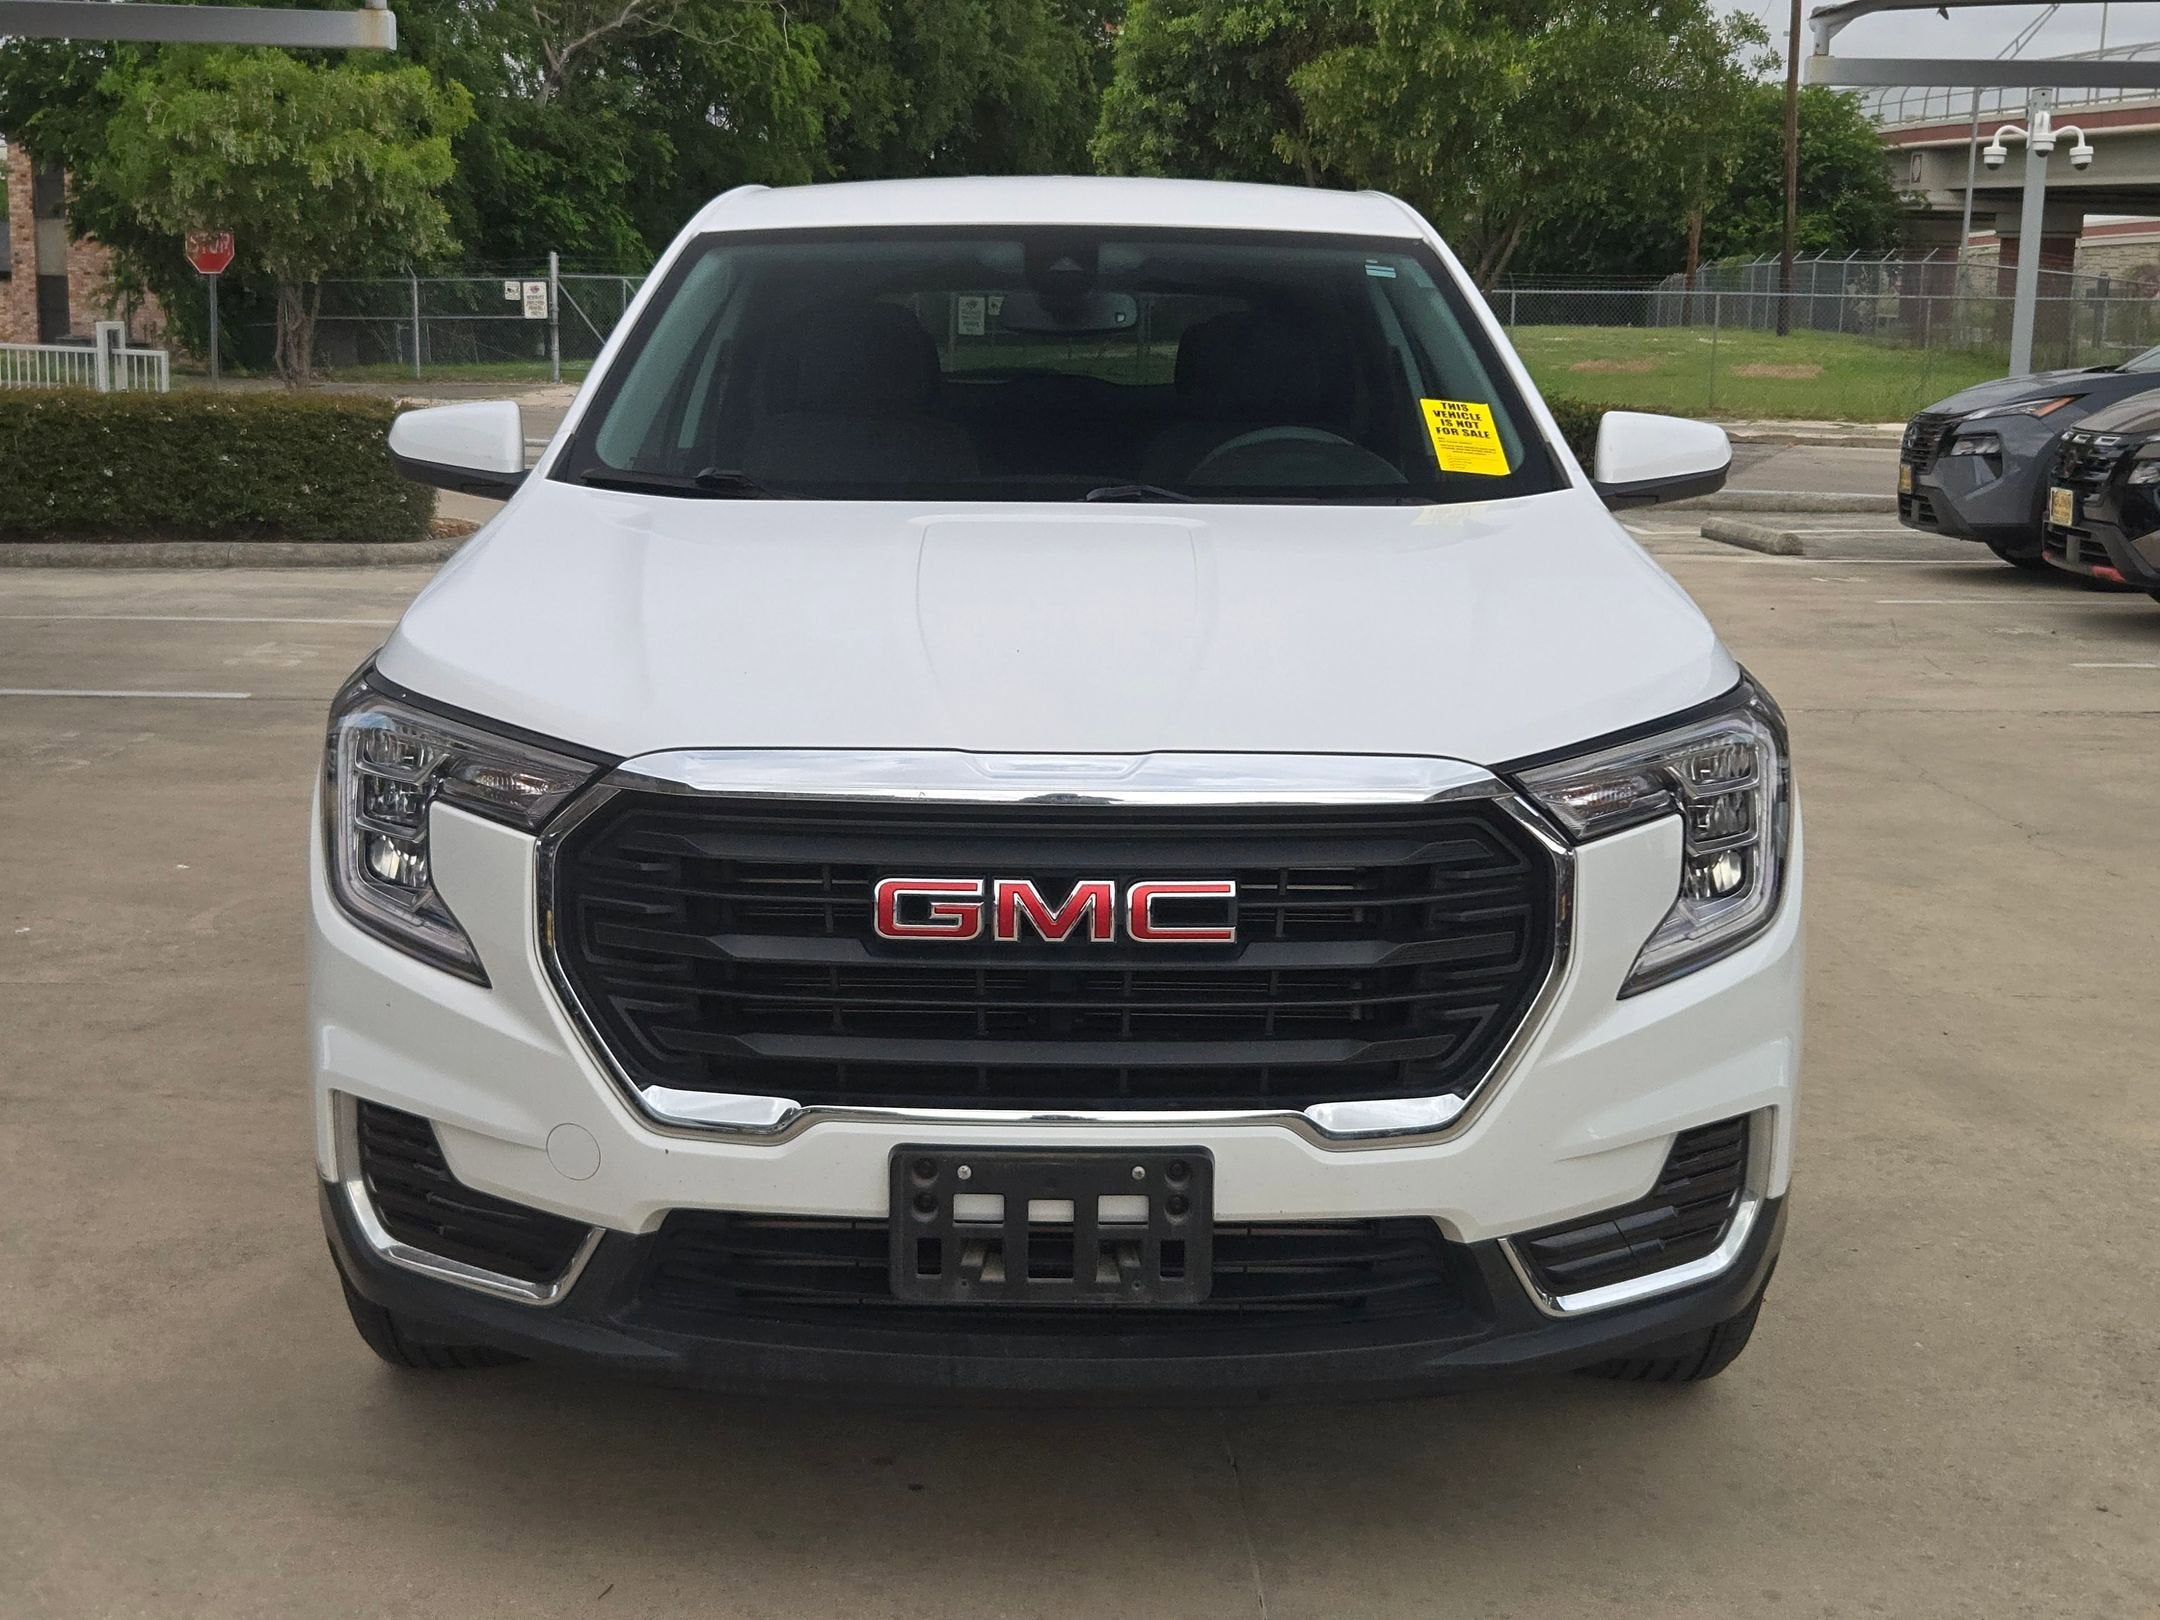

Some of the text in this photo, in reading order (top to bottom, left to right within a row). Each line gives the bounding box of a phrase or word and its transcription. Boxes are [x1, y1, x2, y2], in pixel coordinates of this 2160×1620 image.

[1441, 402, 1469, 412] THIS
[1433, 410, 1482, 421] VEHICLE
[1440, 419, 1479, 429] IS NOT
[1436, 427, 1491, 439] FOR SALE
[873, 877, 1237, 943] GMC
